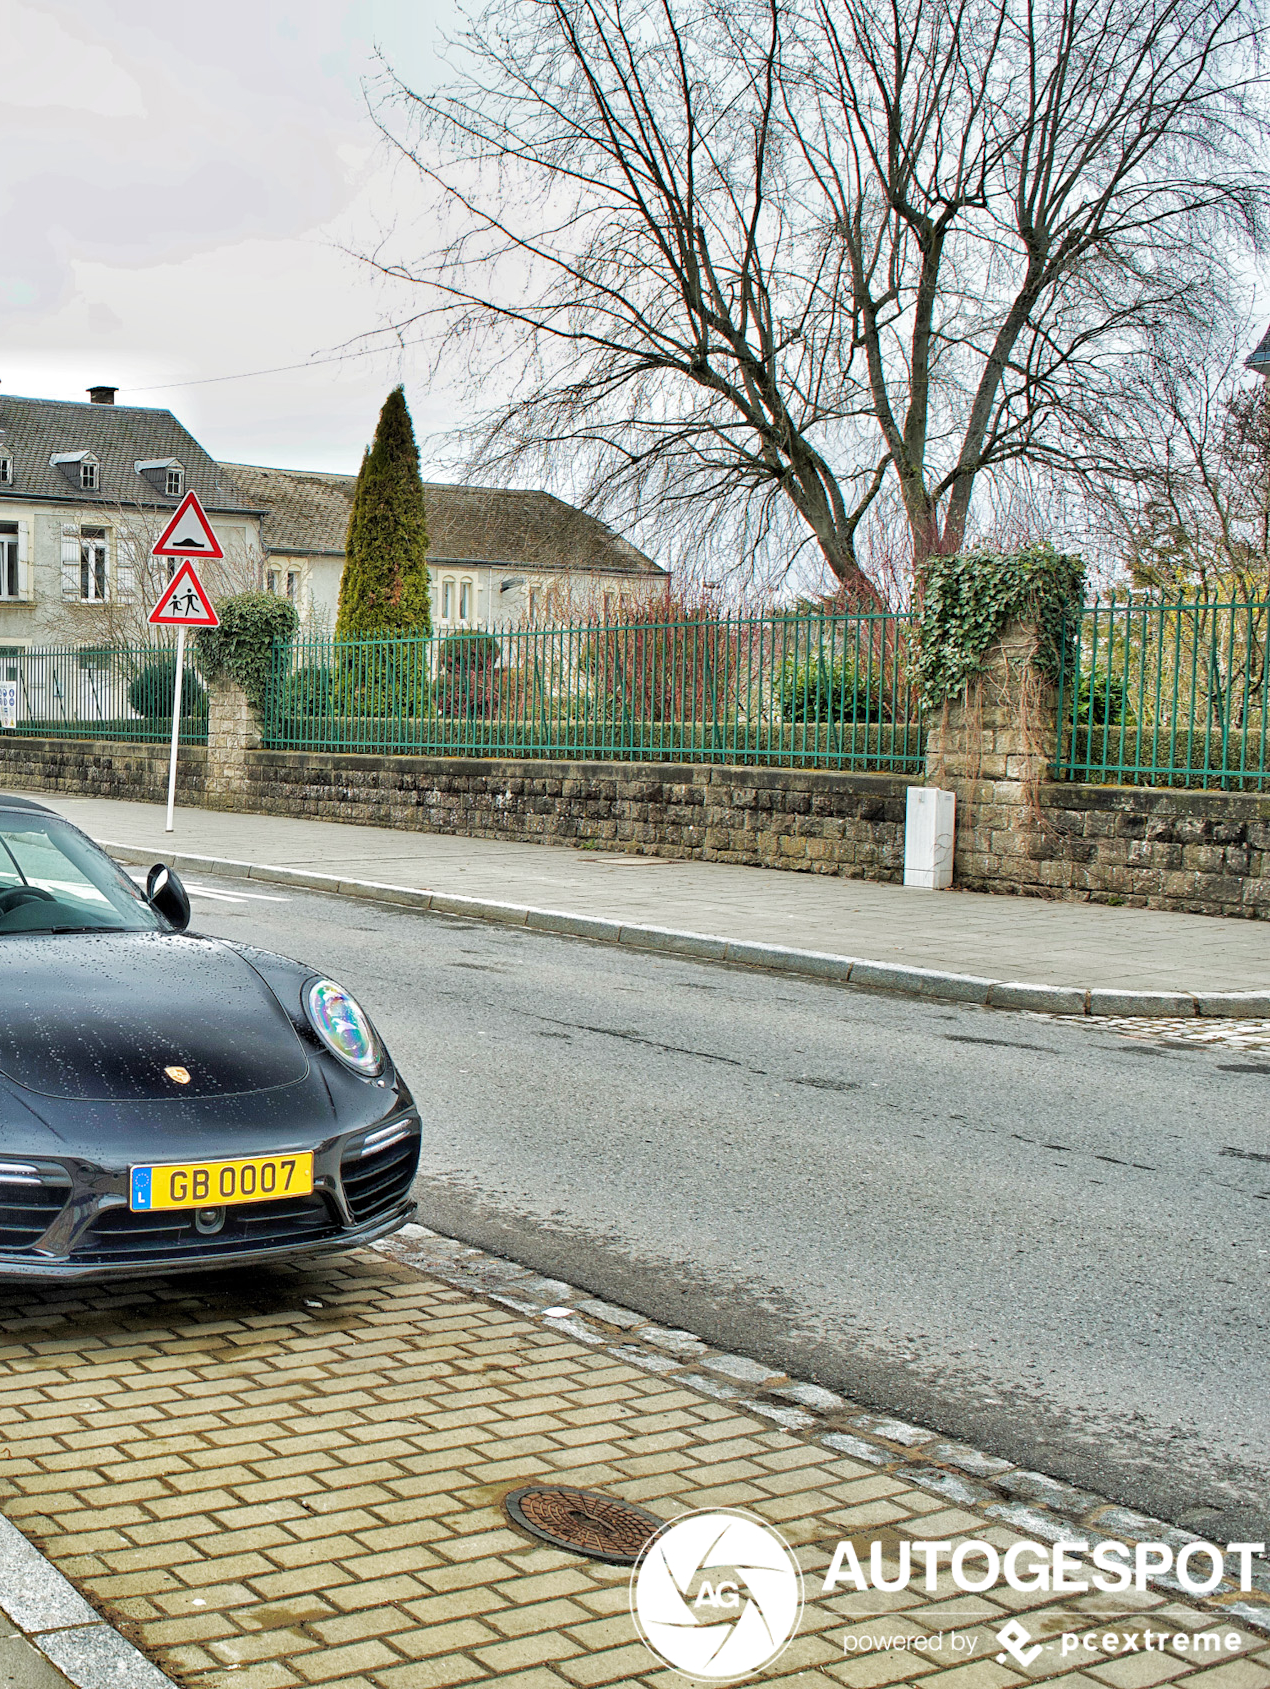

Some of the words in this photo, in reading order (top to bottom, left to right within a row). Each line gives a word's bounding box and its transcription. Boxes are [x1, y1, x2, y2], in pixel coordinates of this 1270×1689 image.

[138, 1192, 145, 1203] L
[170, 1169, 209, 1202] GB
[219, 1160, 296, 1198] 0007
